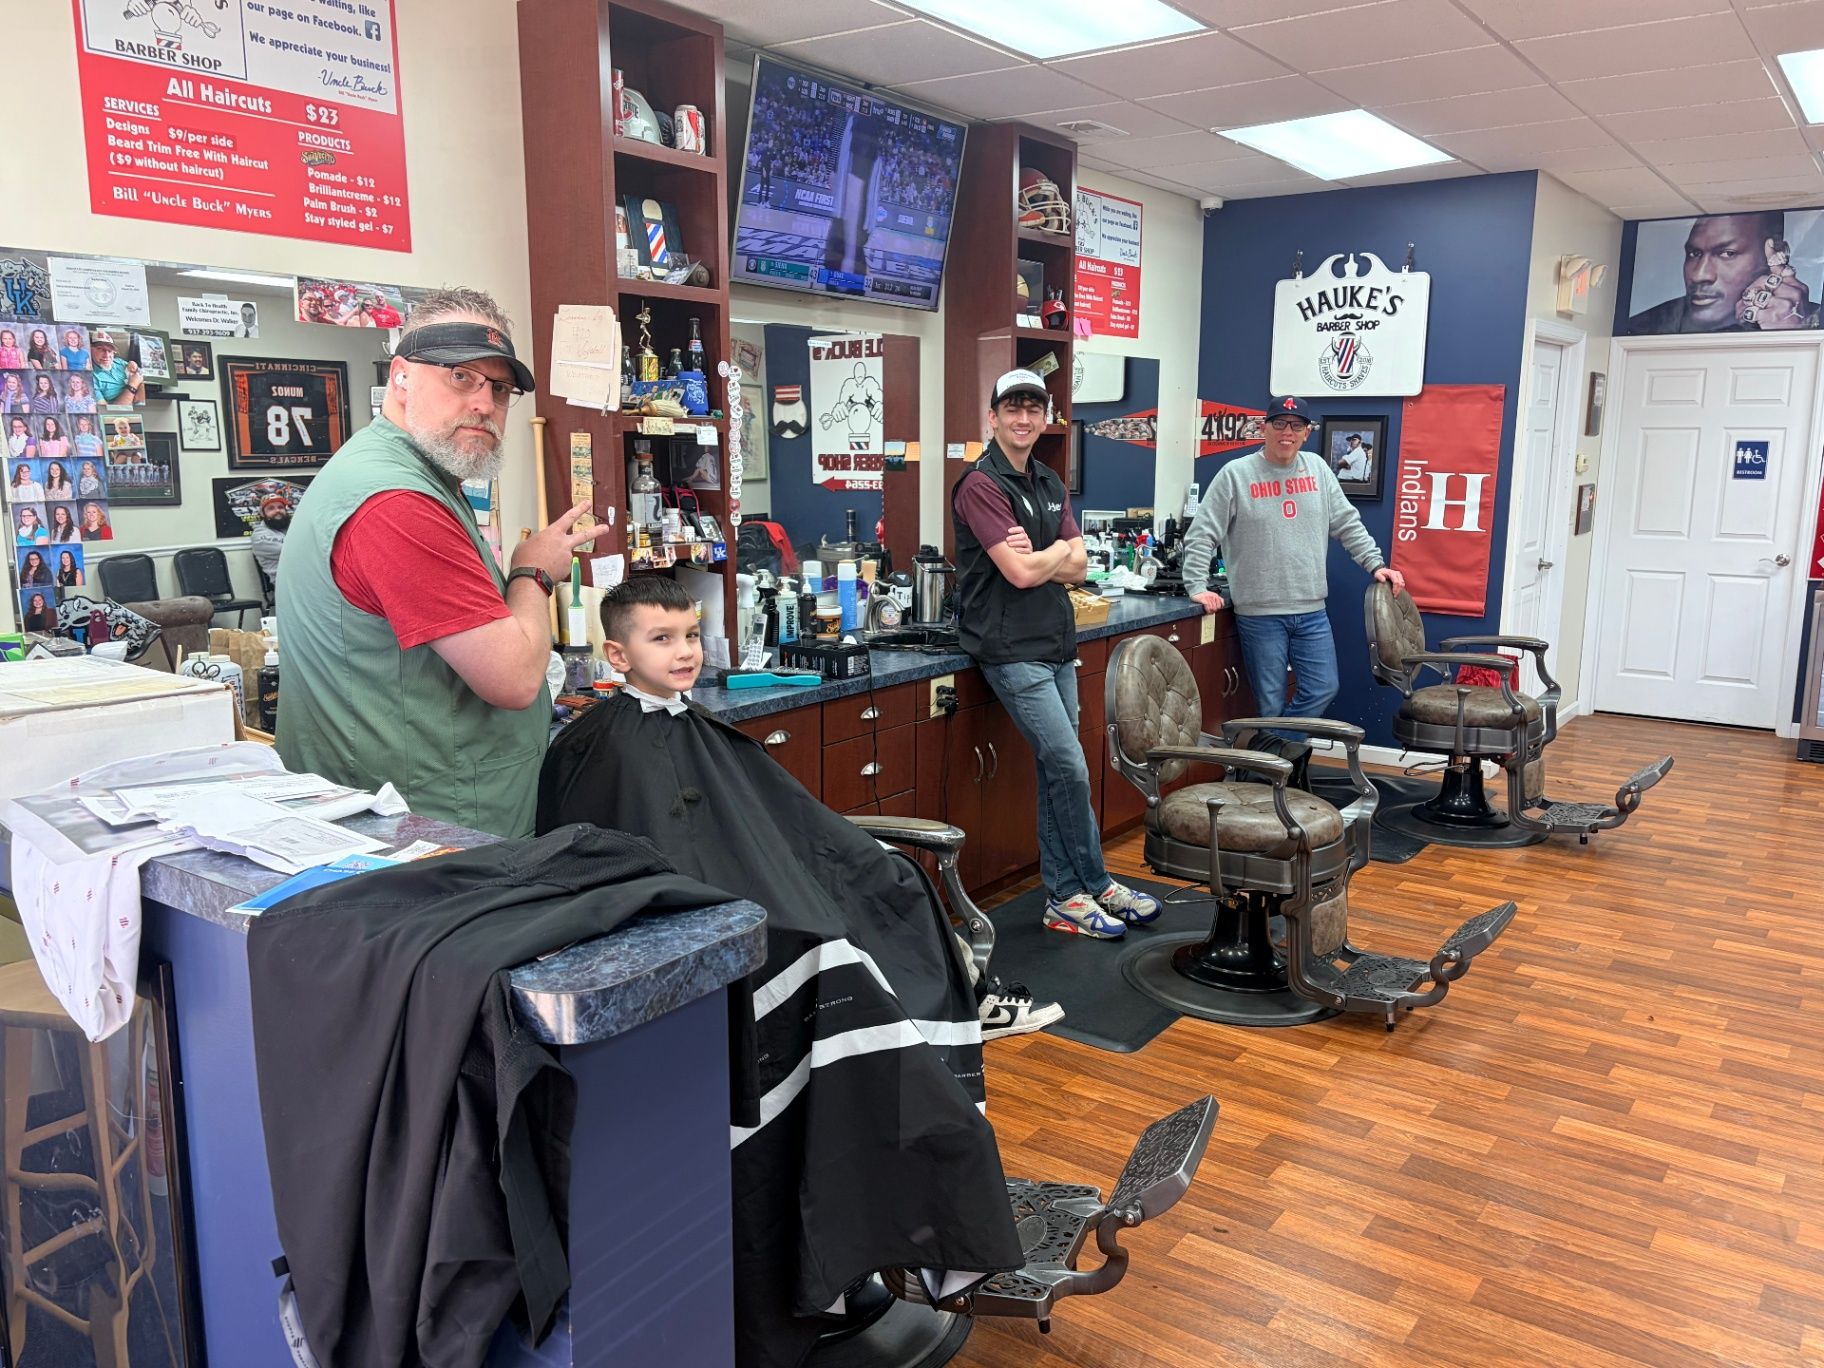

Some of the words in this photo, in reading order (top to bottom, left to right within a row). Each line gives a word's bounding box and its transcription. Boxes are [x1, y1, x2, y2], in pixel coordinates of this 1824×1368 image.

[247, 2, 265, 12] our
[268, 6, 294, 20] page
[297, 13, 310, 24] on
[313, 12, 362, 36] Facebook.
[358, 5, 376, 17] like
[115, 39, 177, 63] BARBER
[182, 52, 222, 71] SHOP
[249, 31, 265, 44] We
[269, 38, 323, 58] appreciate
[325, 51, 348, 63] your
[350, 55, 391, 73] business!
[104, 97, 160, 116] SERVICES
[166, 77, 194, 99] All
[200, 83, 272, 113] Haircuts
[305, 103, 339, 125] $23
[106, 118, 150, 135] Designs
[168, 127, 208, 145] $9/per
[211, 136, 234, 148] side
[298, 131, 351, 151] PRODUCTS
[107, 134, 144, 150] Beard
[147, 140, 172, 155] Trim
[176, 145, 200, 159] Free
[203, 150, 228, 164] With
[231, 154, 269, 170] Haircut
[134, 157, 178, 172] without
[182, 162, 224, 180] haircut)
[307, 167, 347, 183] Pomade
[357, 176, 375, 188] $12
[113, 186, 138, 201] Bill
[308, 182, 374, 202] Brilliantcreme
[383, 195, 401, 207] $12
[303, 197, 327, 210] Palm
[330, 201, 356, 214] Brush
[365, 207, 378, 218] $2
[304, 212, 325, 226] Stay
[327, 216, 356, 230] styled
[359, 221, 374, 233] gel
[382, 224, 394, 235] $7
[3, 277, 38, 316] UK
[1296, 285, 1405, 322] HAUKE'S
[1316, 321, 1351, 332] BARBER
[1355, 320, 1380, 331] SHOP
[1321, 366, 1347, 390] HAIRCUTS
[1350, 365, 1369, 388] SHAVES
[1250, 480, 1282, 499] OHIO
[1285, 476, 1319, 495] STATE
[1398, 459, 1429, 541] Indians
[1420, 471, 1491, 532] H
[786, 603, 795, 639] IMPROVE
